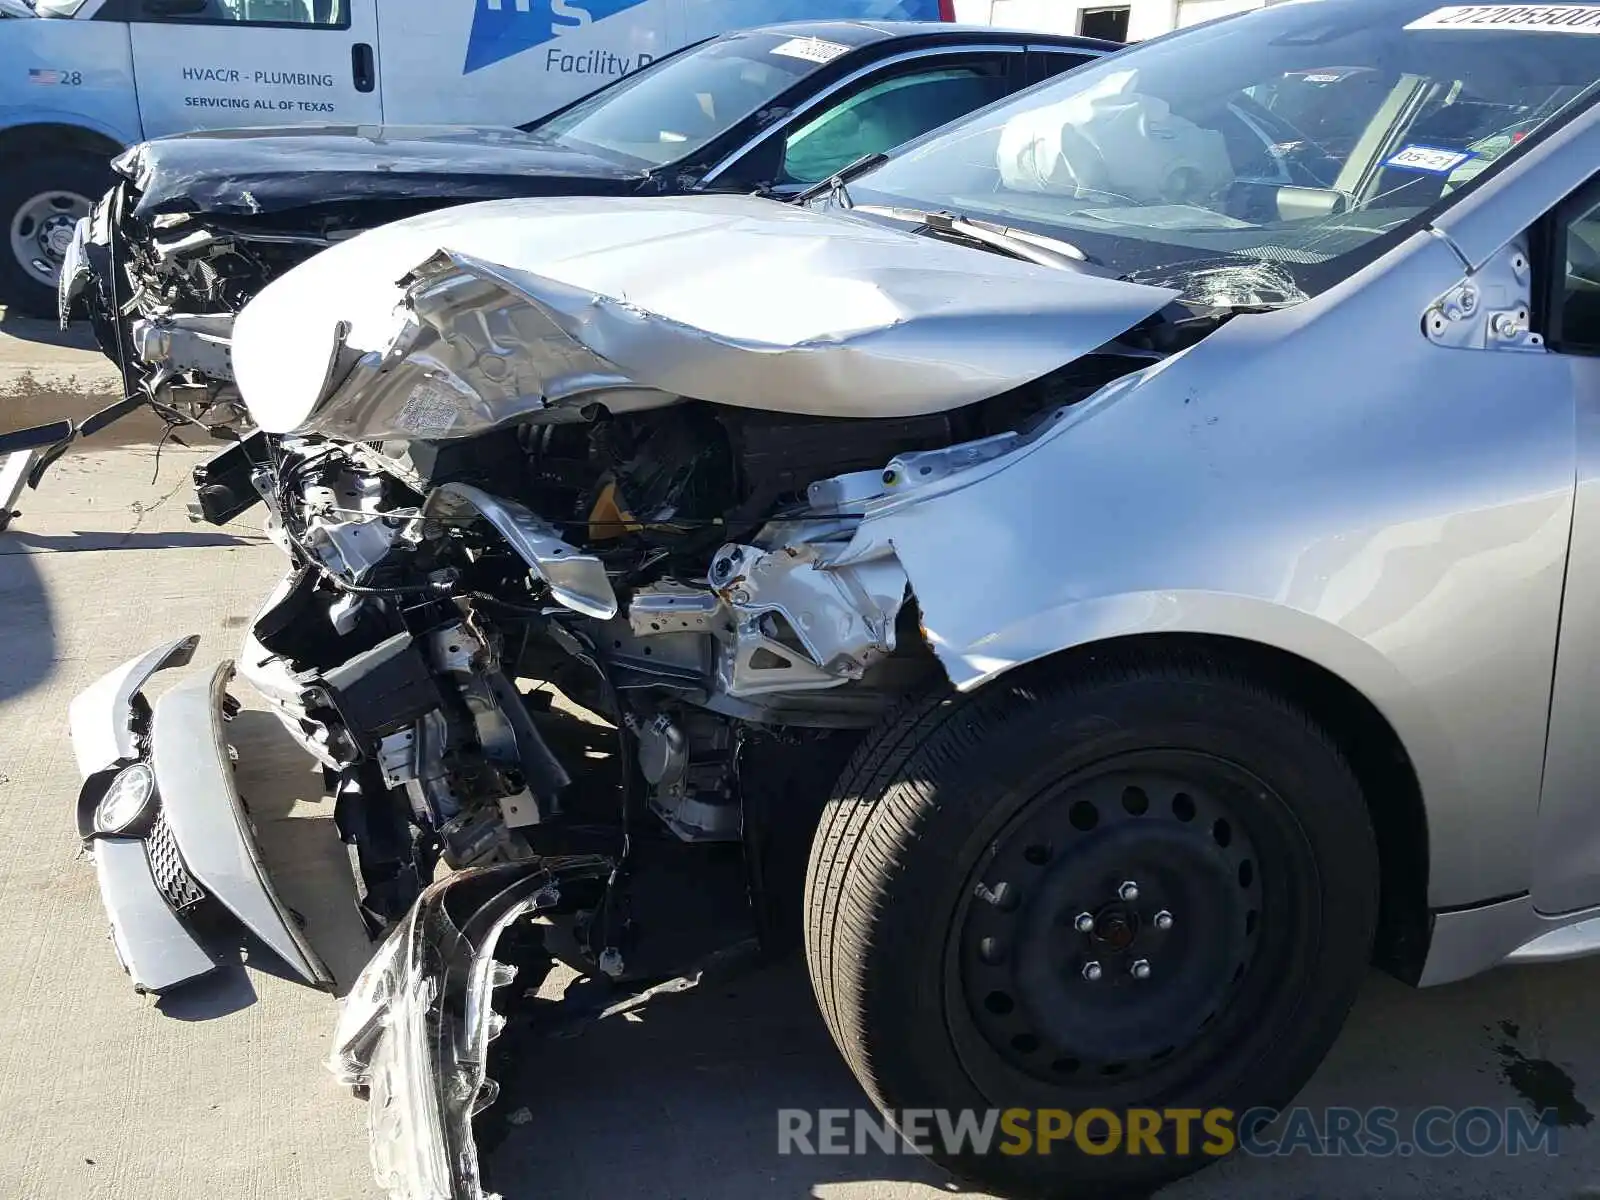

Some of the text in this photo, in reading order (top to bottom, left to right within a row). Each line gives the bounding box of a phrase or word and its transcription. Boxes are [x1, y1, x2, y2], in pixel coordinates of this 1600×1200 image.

[546, 49, 630, 76] Facility
[60, 70, 82, 85] 28
[182, 67, 240, 83] HVAC/R
[254, 71, 334, 87] PLUMBING
[184, 96, 335, 113] SERVICING ALL OF TEXAS
